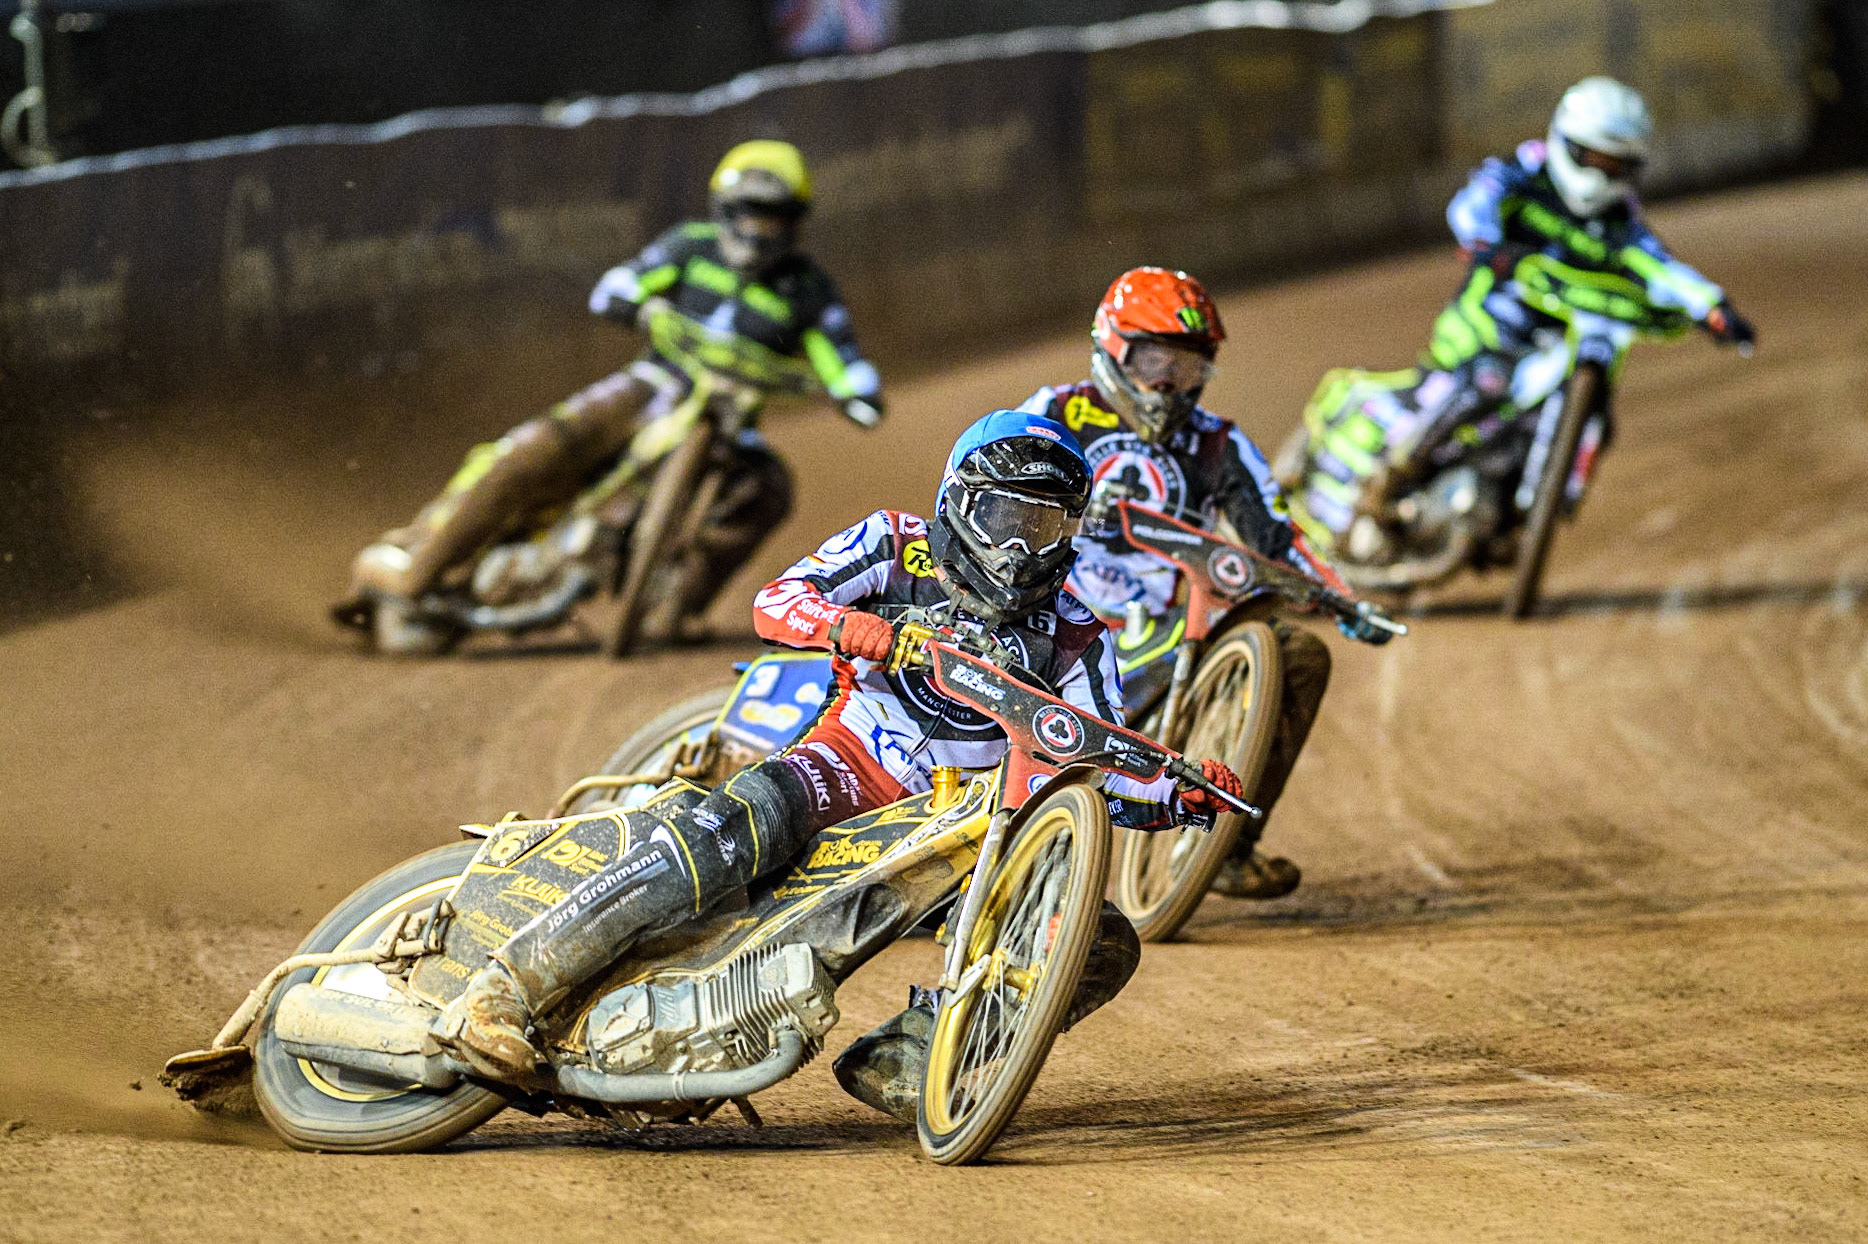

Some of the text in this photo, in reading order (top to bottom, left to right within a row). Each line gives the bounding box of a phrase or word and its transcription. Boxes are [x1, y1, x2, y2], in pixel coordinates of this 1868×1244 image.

[488, 829, 530, 863] 6
[548, 901, 579, 934] Jörg
[579, 849, 663, 905] Grohmann
